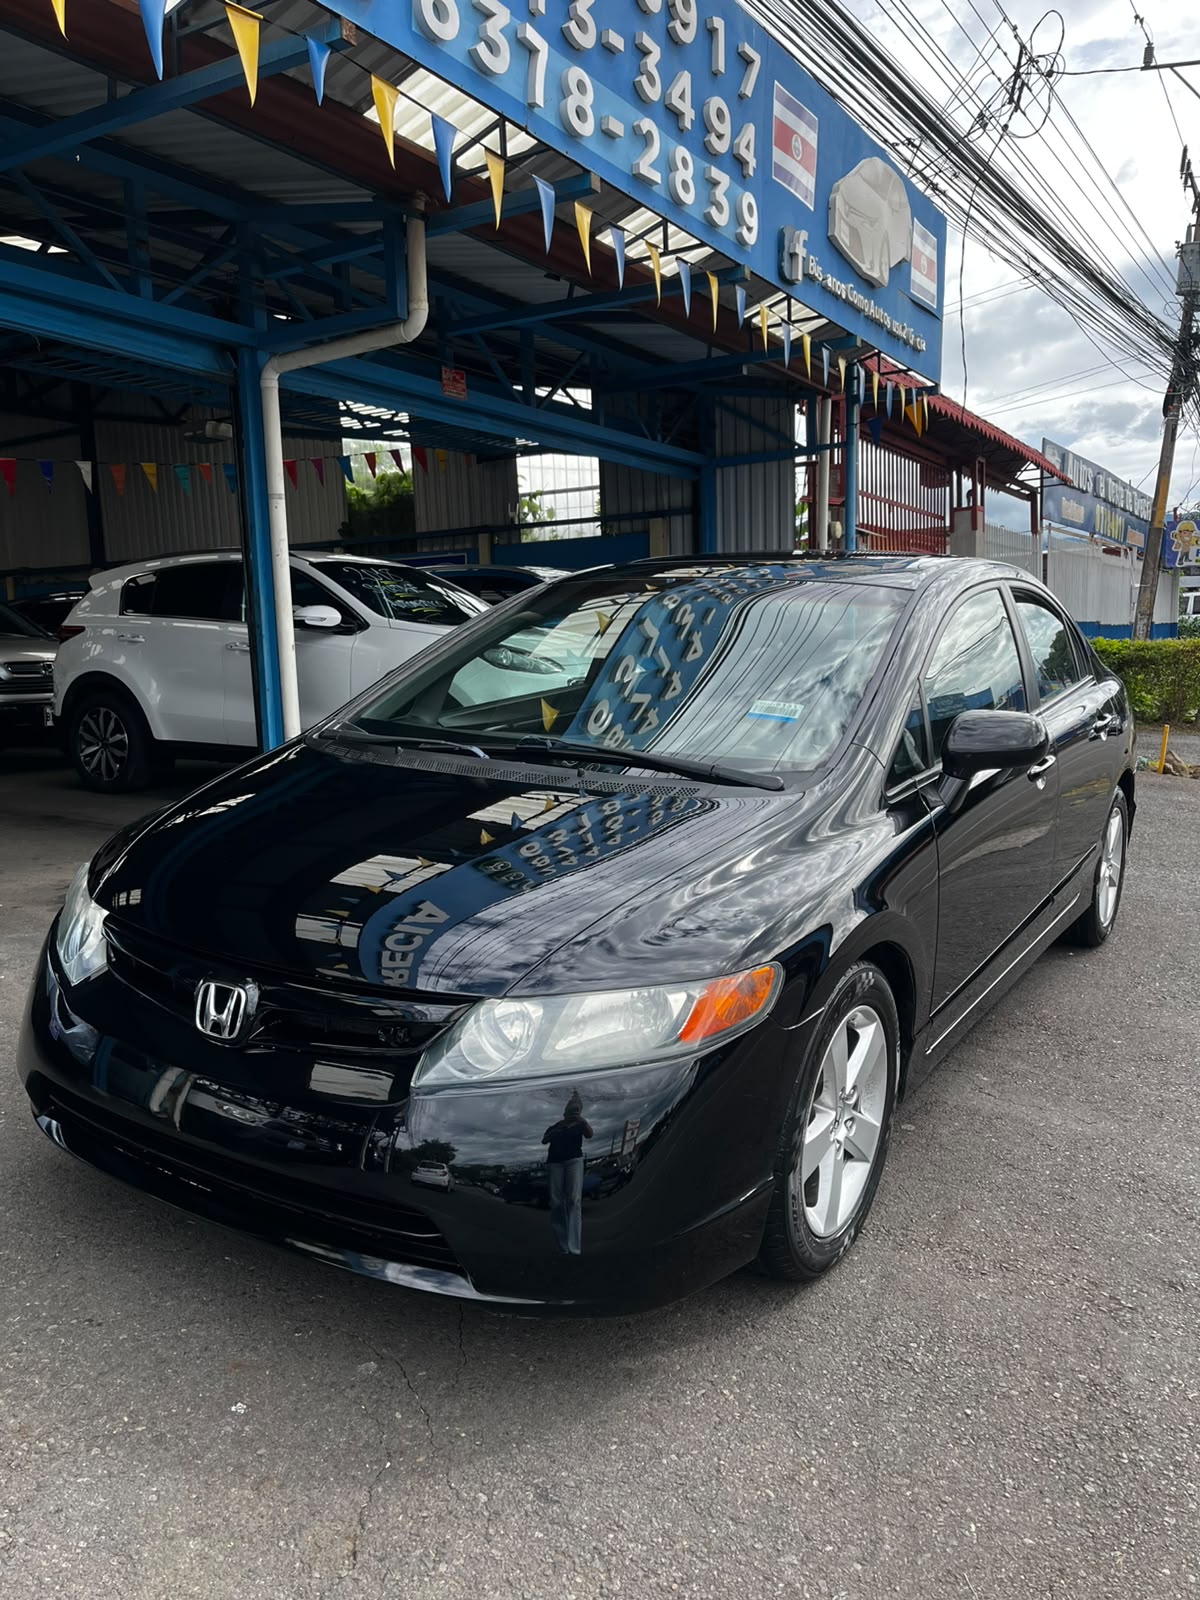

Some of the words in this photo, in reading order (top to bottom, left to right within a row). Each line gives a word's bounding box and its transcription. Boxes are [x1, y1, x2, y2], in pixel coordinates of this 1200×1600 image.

[638, 0, 762, 99] 917
[529, 0, 757, 179] 3-3494
[870, 299, 892, 329] Autos
[1067, 452, 1094, 495] Autos
